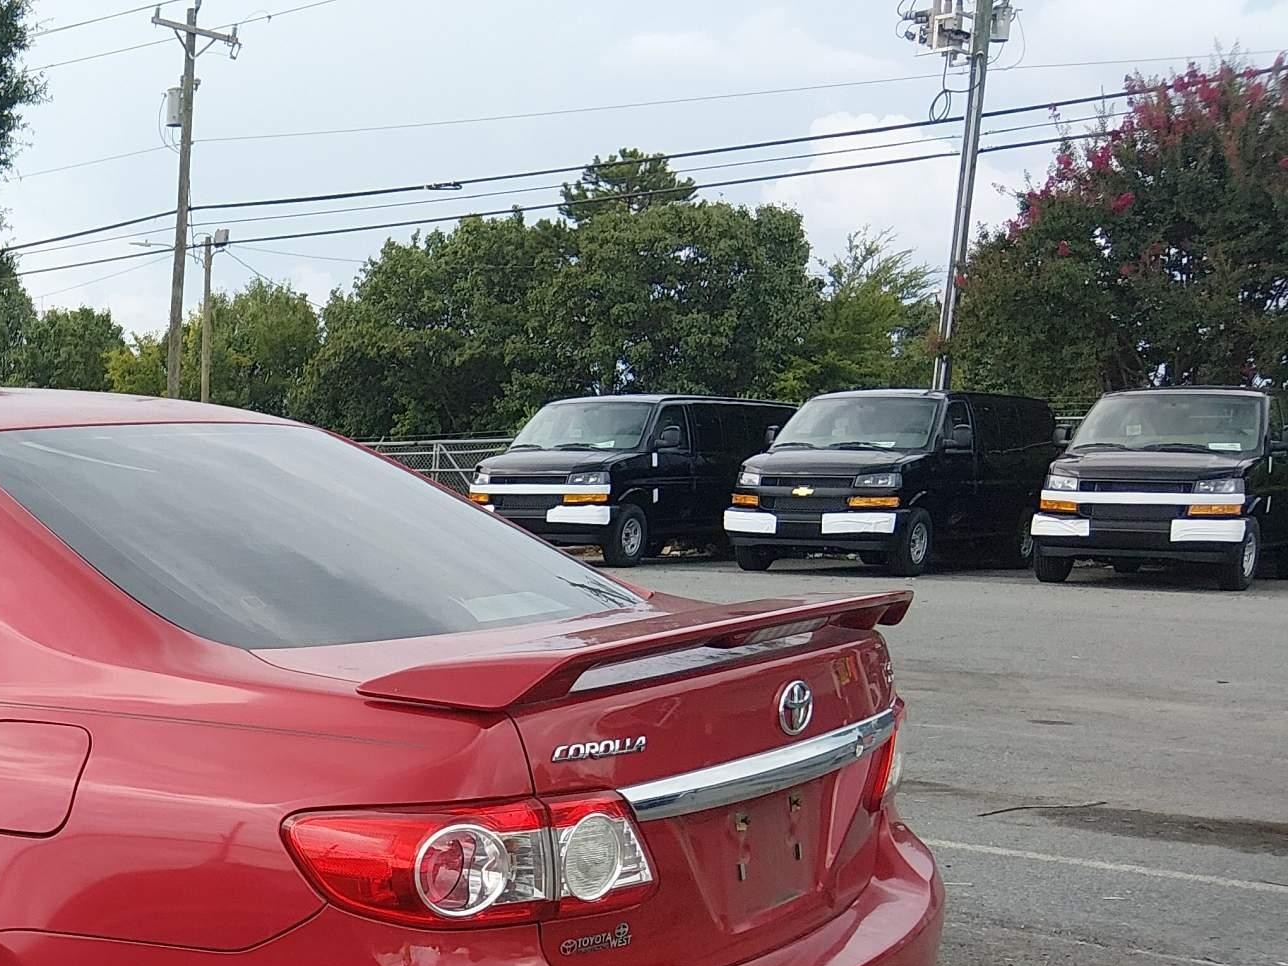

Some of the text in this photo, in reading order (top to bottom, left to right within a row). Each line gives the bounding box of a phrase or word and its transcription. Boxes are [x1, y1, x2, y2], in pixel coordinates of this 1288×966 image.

[551, 735, 647, 762] COROLLA
[577, 932, 612, 948] TOYOTA
[610, 934, 632, 948] WEST
